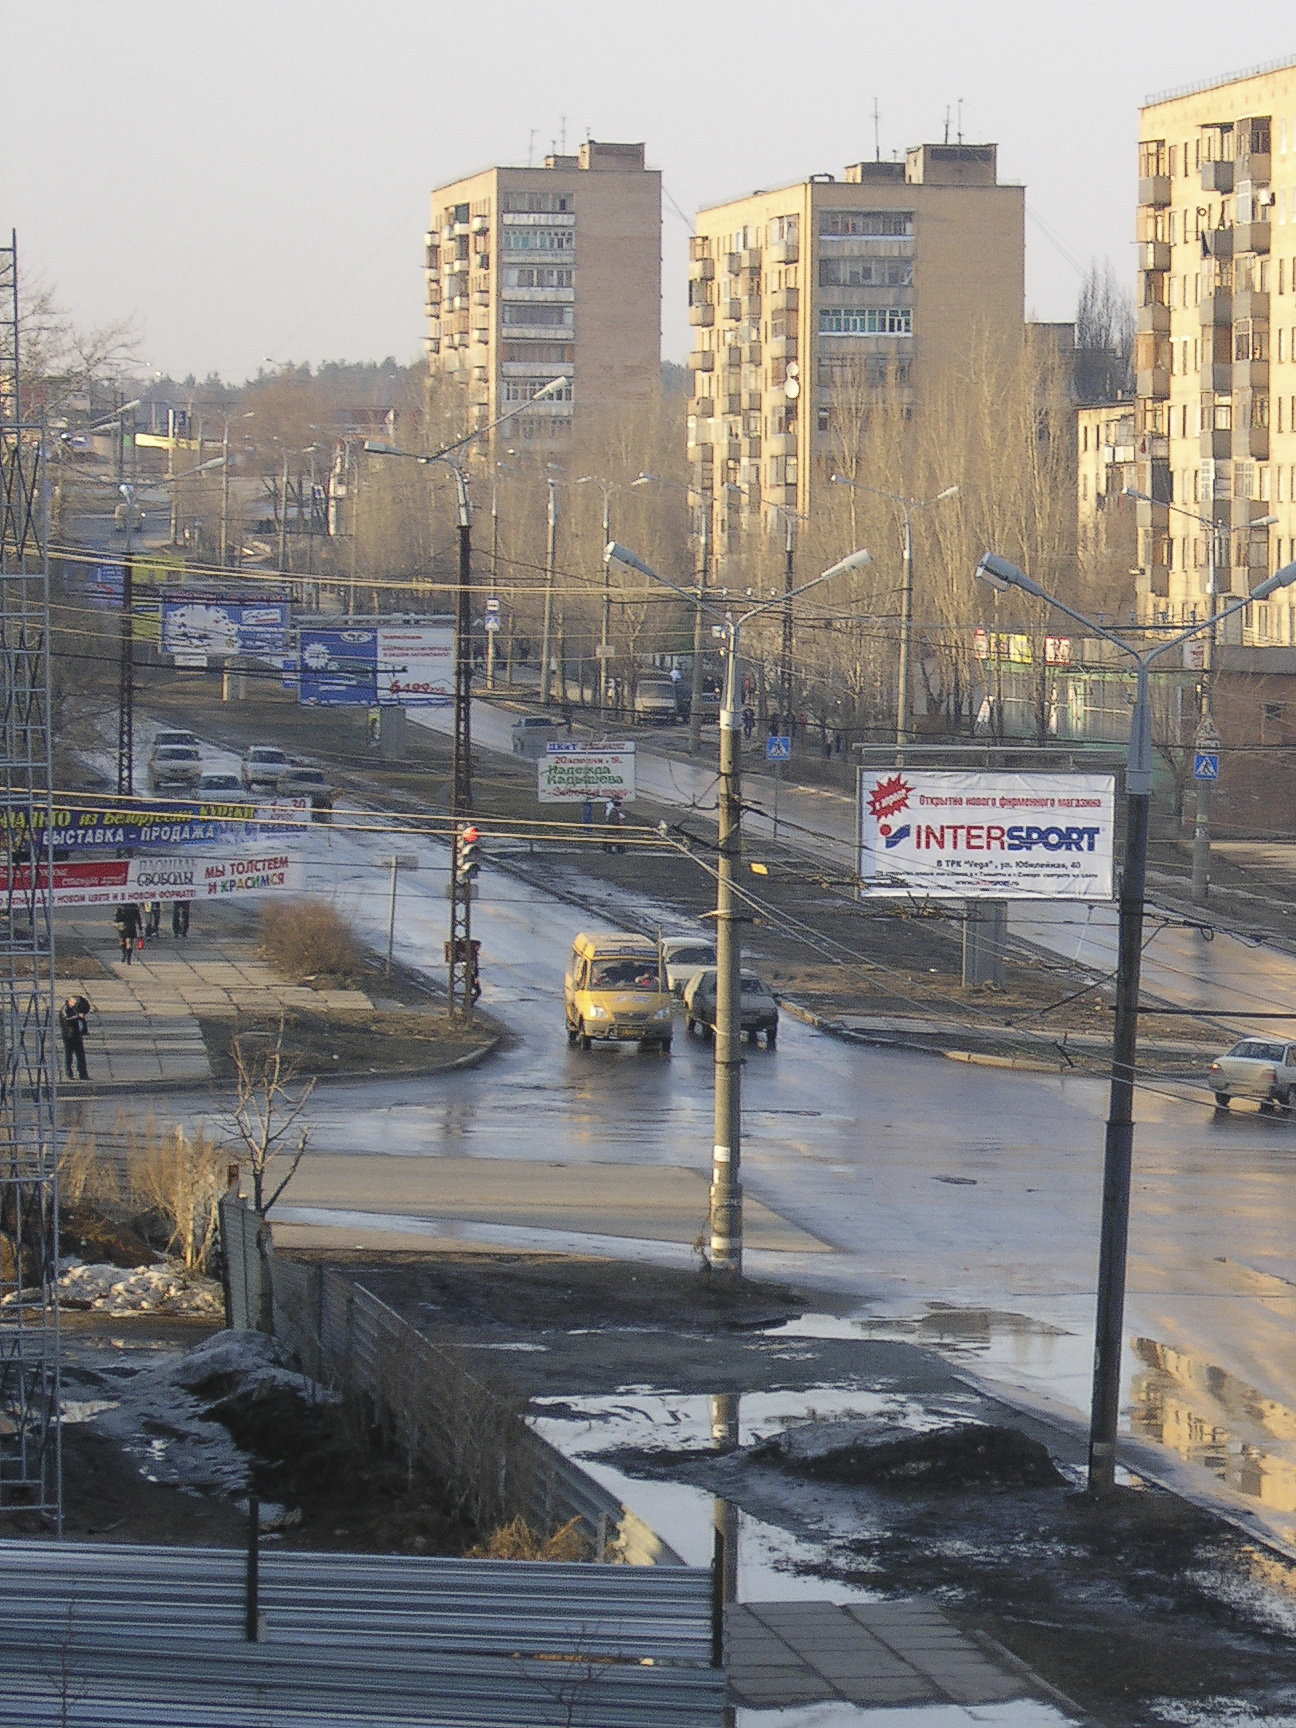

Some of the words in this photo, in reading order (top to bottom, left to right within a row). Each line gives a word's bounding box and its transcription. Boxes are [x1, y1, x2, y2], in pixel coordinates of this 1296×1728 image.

[548, 765, 611, 775] Надежда
[547, 775, 624, 786] Кадышева
[919, 795, 963, 808] Открытие
[965, 797, 997, 807] нового
[998, 796, 1056, 809] фирменного
[1058, 797, 1101, 808] магазина
[141, 825, 215, 842] ПРОДАЖА
[916, 824, 1101, 852] INTERSPORT
[205, 864, 226, 879] МЫ
[229, 856, 289, 876] ТОЛСТЕЕМ
[946, 860, 962, 868] ТРК
[1015, 860, 1068, 870] Юбилейная,
[137, 870, 194, 887] СВОБОДЫ
[220, 872, 285, 893] КРАСИМСЯ
